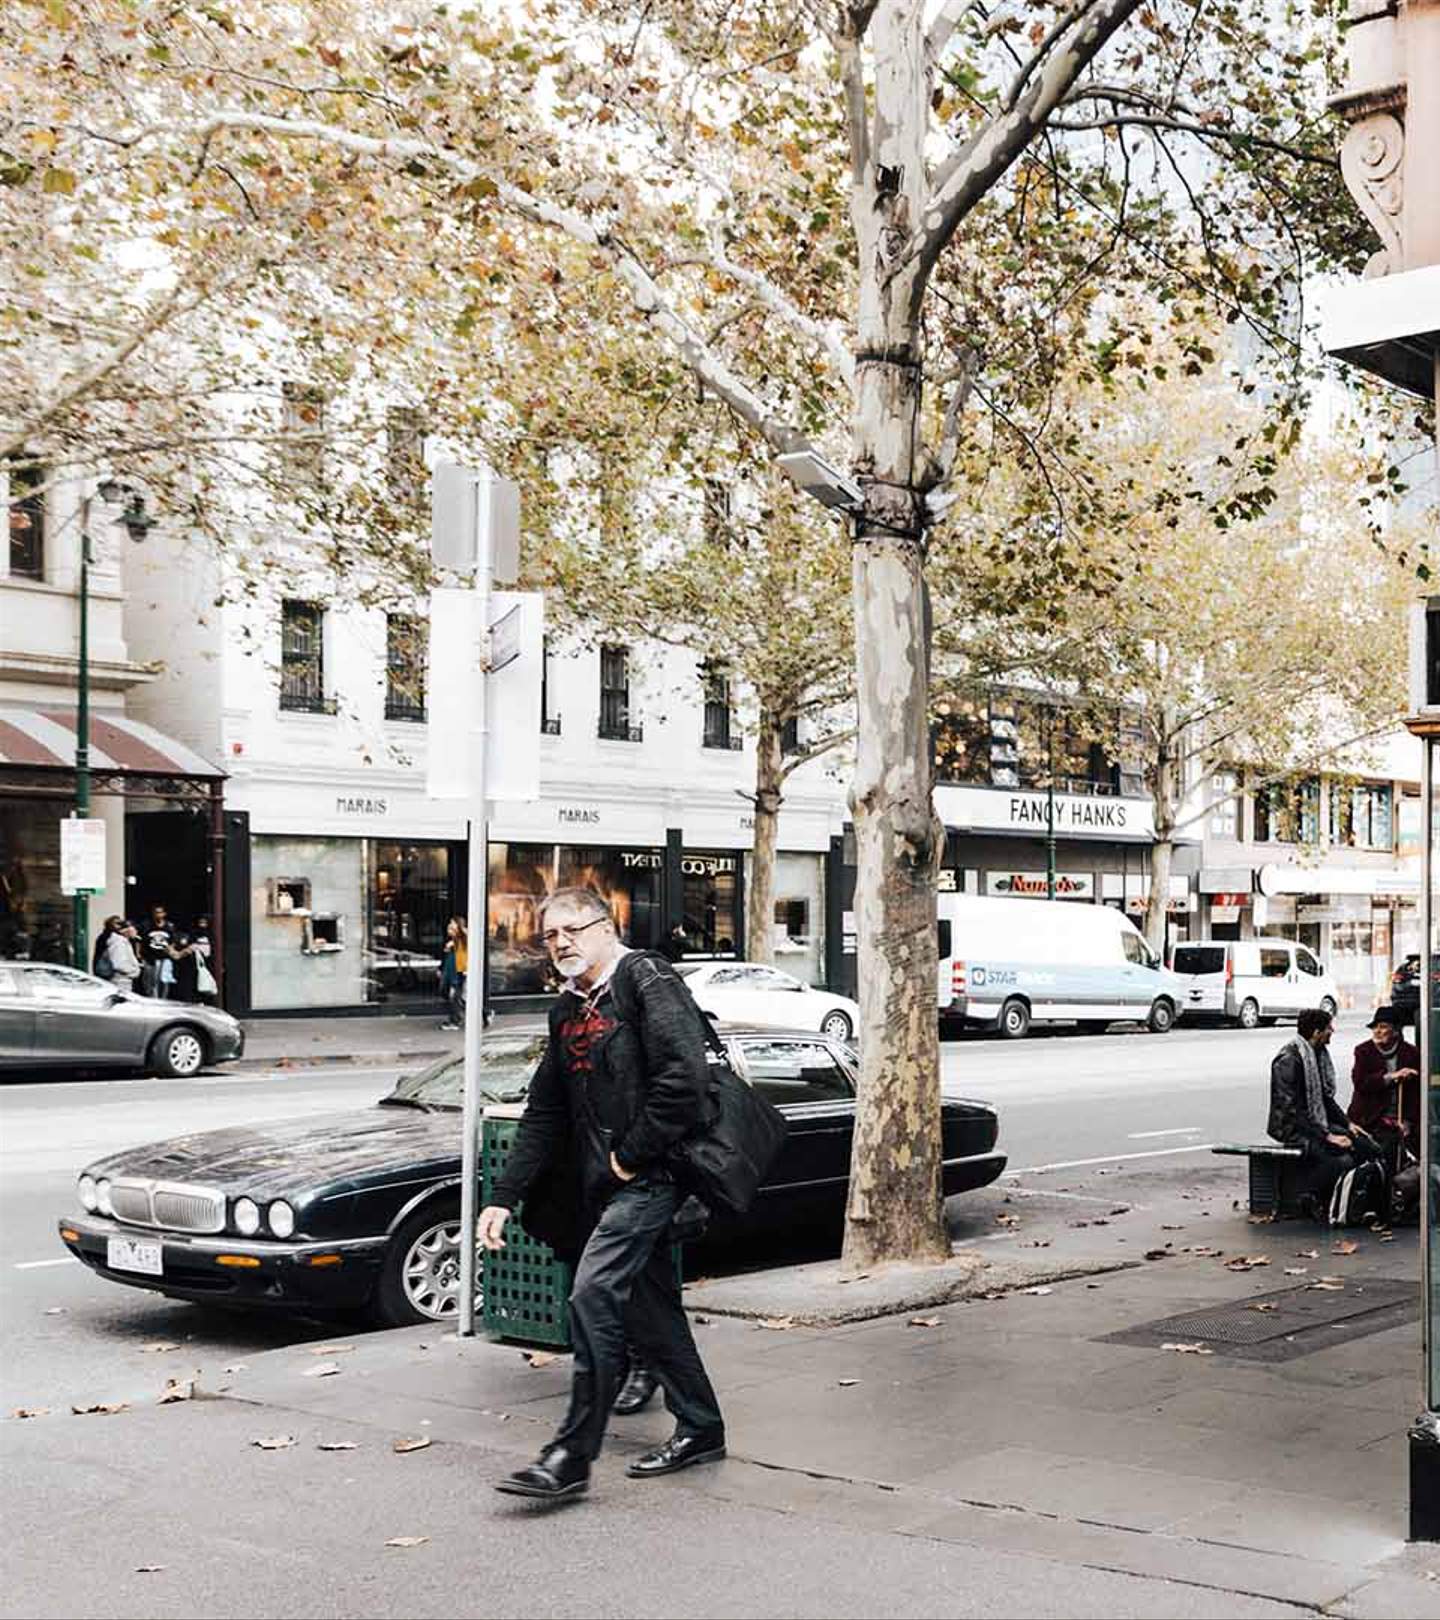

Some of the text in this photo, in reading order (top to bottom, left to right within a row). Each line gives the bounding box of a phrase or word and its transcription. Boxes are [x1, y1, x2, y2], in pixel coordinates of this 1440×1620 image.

[337, 798, 387, 814] MARAIS
[1010, 799, 1127, 828] FANCY HANK'S
[558, 809, 601, 823] MARAIS
[1009, 875, 1079, 893] Nano's
